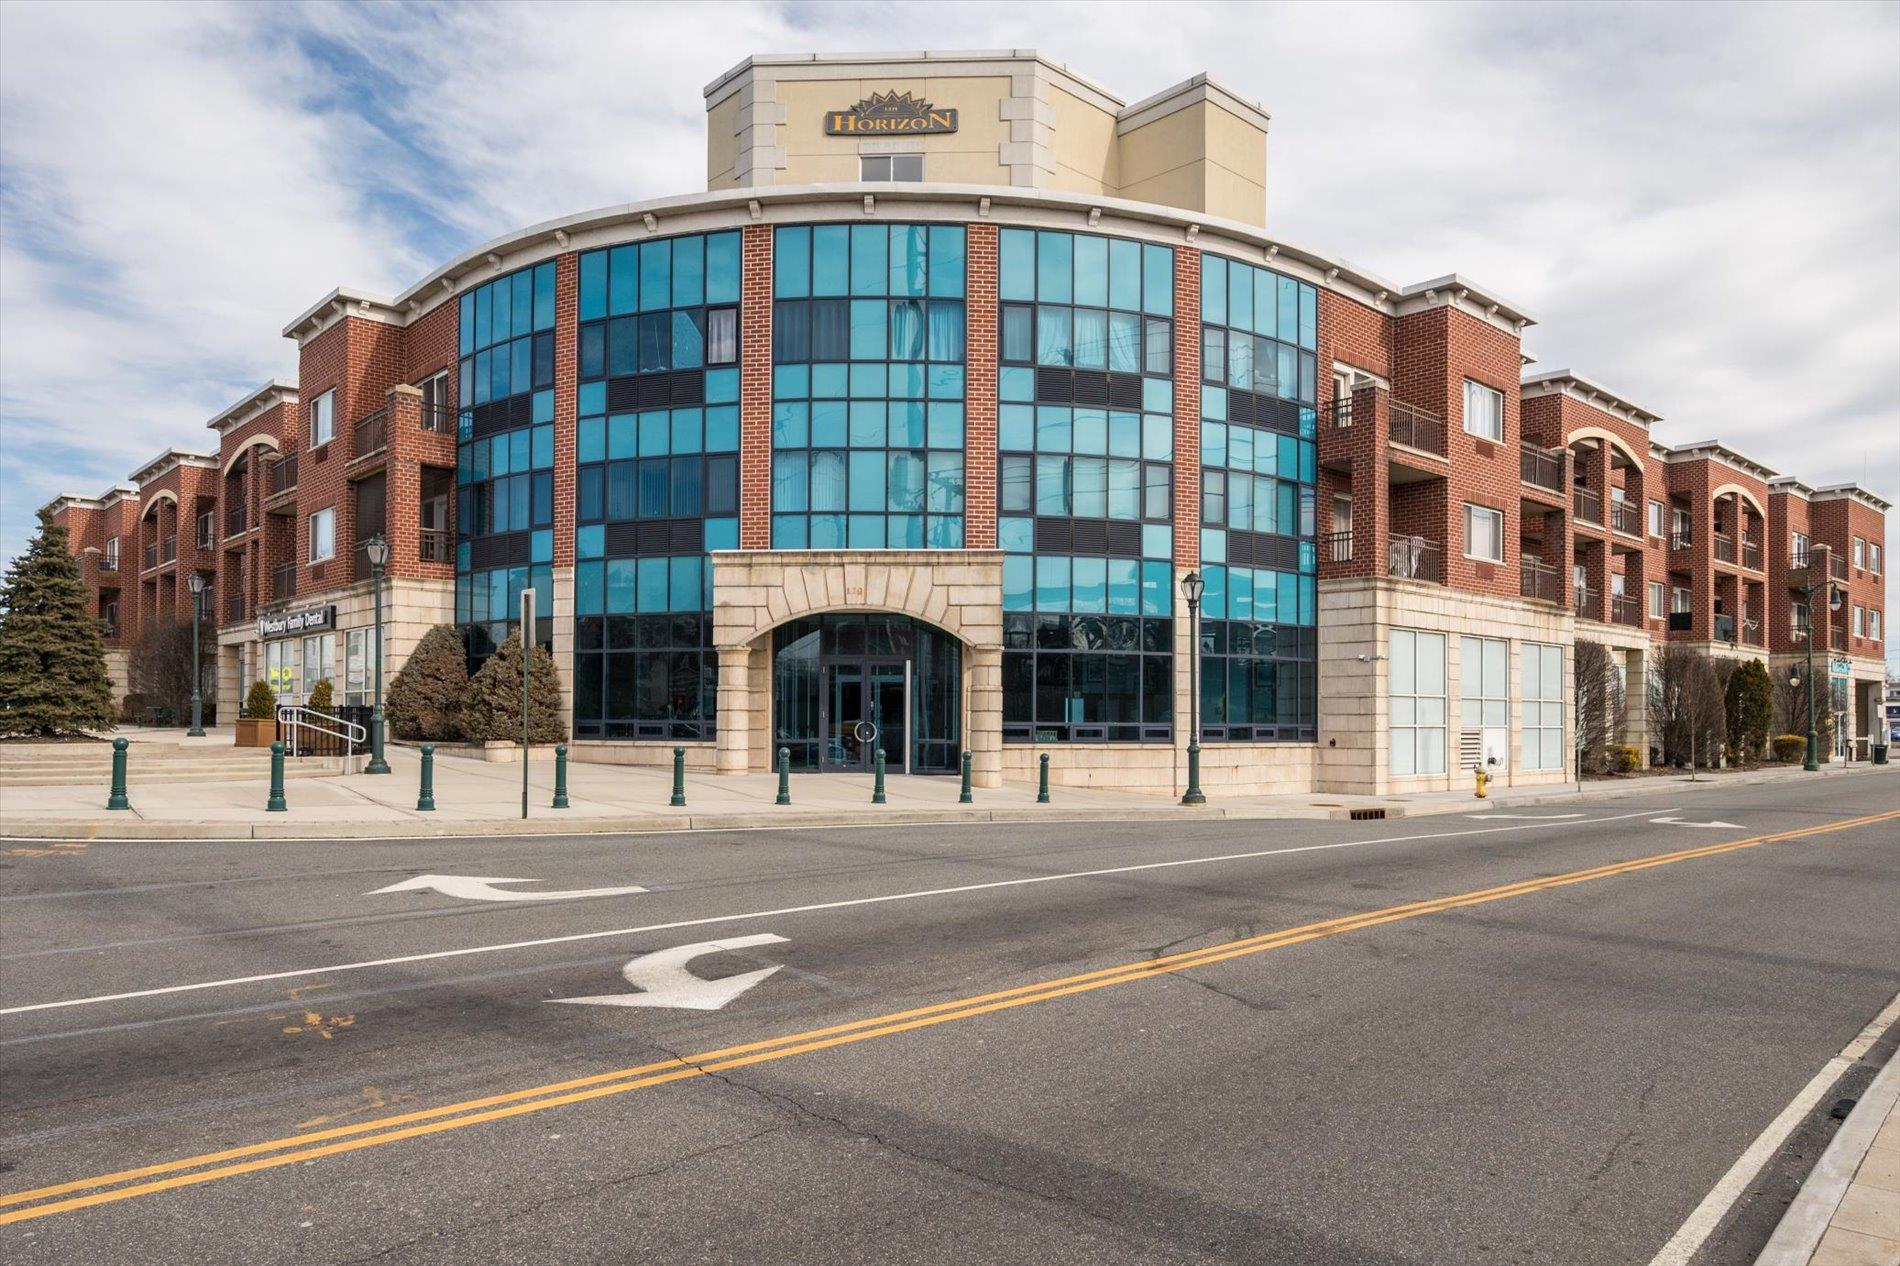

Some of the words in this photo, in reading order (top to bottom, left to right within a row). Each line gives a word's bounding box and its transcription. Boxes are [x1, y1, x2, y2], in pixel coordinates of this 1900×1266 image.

[833, 112, 951, 131] HORIZON
[287, 614, 304, 630] Family
[305, 610, 324, 627] Dental
